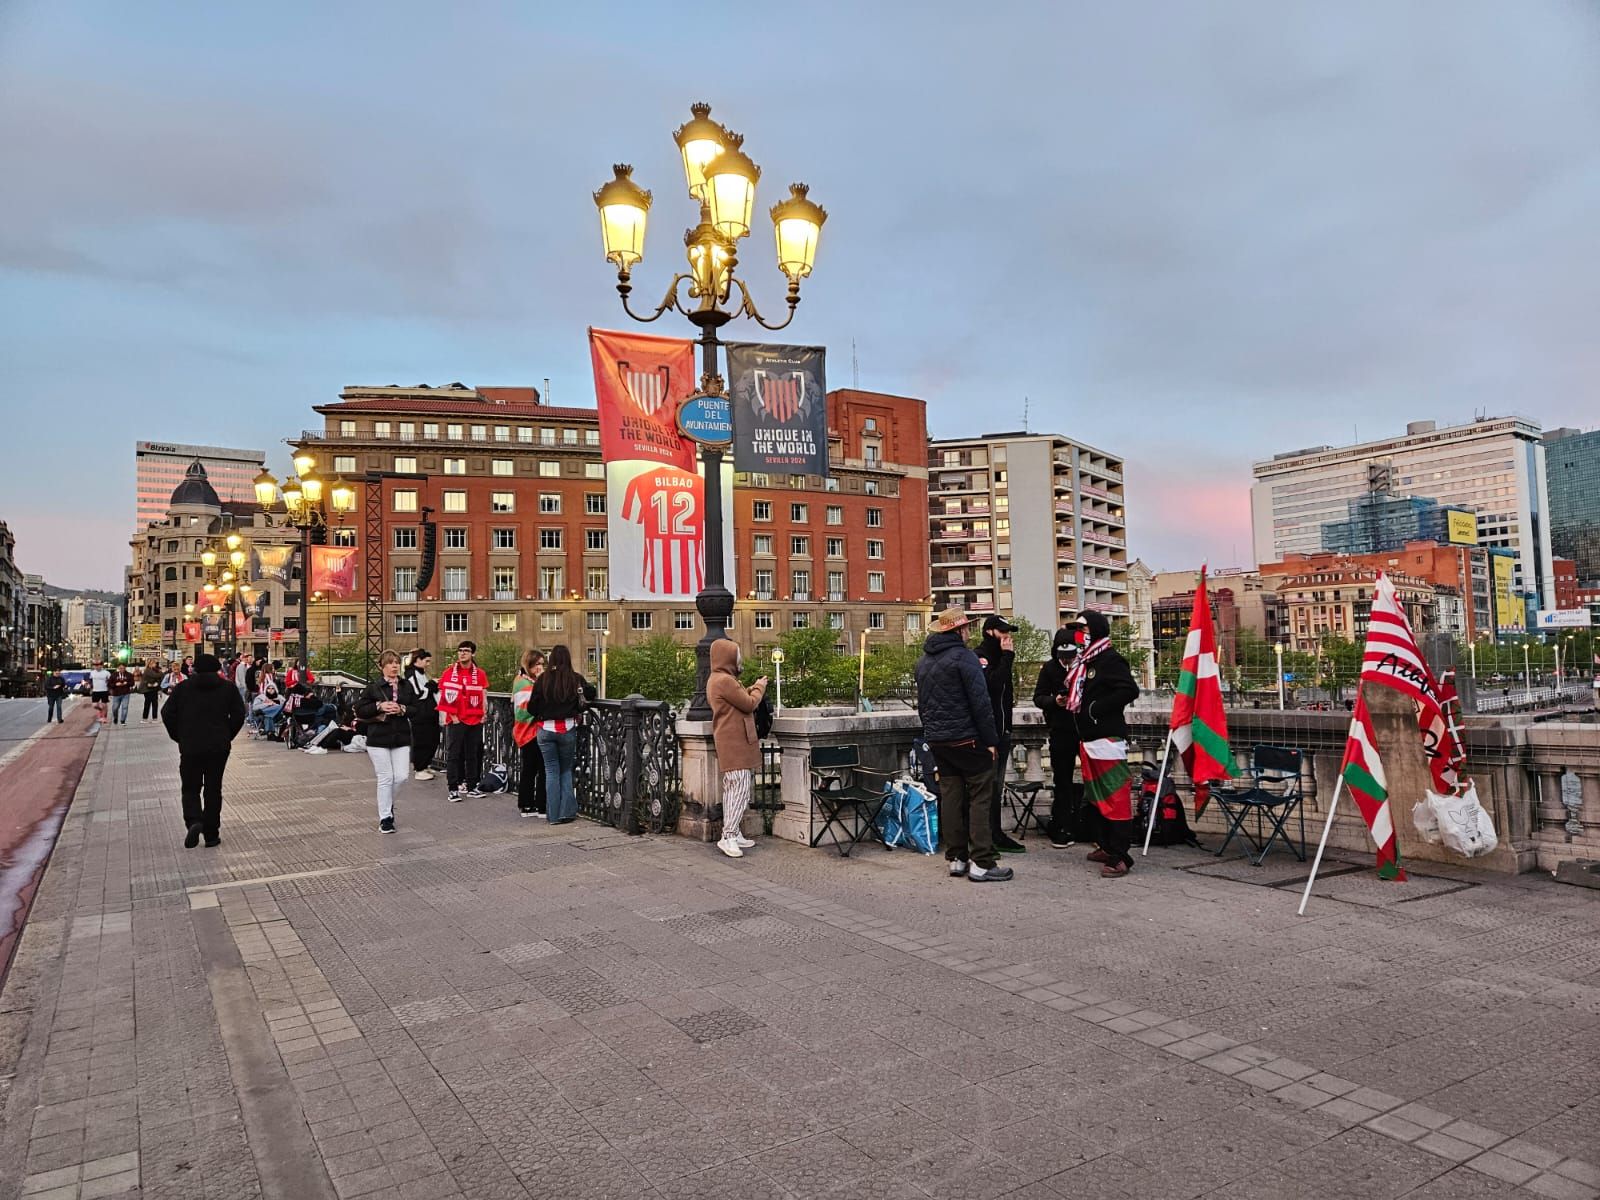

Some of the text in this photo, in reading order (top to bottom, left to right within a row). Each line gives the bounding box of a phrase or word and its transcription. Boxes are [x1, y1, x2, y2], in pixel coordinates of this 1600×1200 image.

[698, 400, 730, 411] PUENTE
[704, 410, 723, 420] DEL
[622, 416, 663, 434] UNIQUE
[619, 428, 681, 451] THE WORLD
[755, 429, 813, 443] UNIQUE IN
[633, 443, 658, 453] SEVILLA
[751, 441, 817, 456] THE WORLD
[765, 456, 806, 465] SEVILLA 2024
[655, 477, 693, 489] BILBAO
[650, 490, 696, 536] 12
